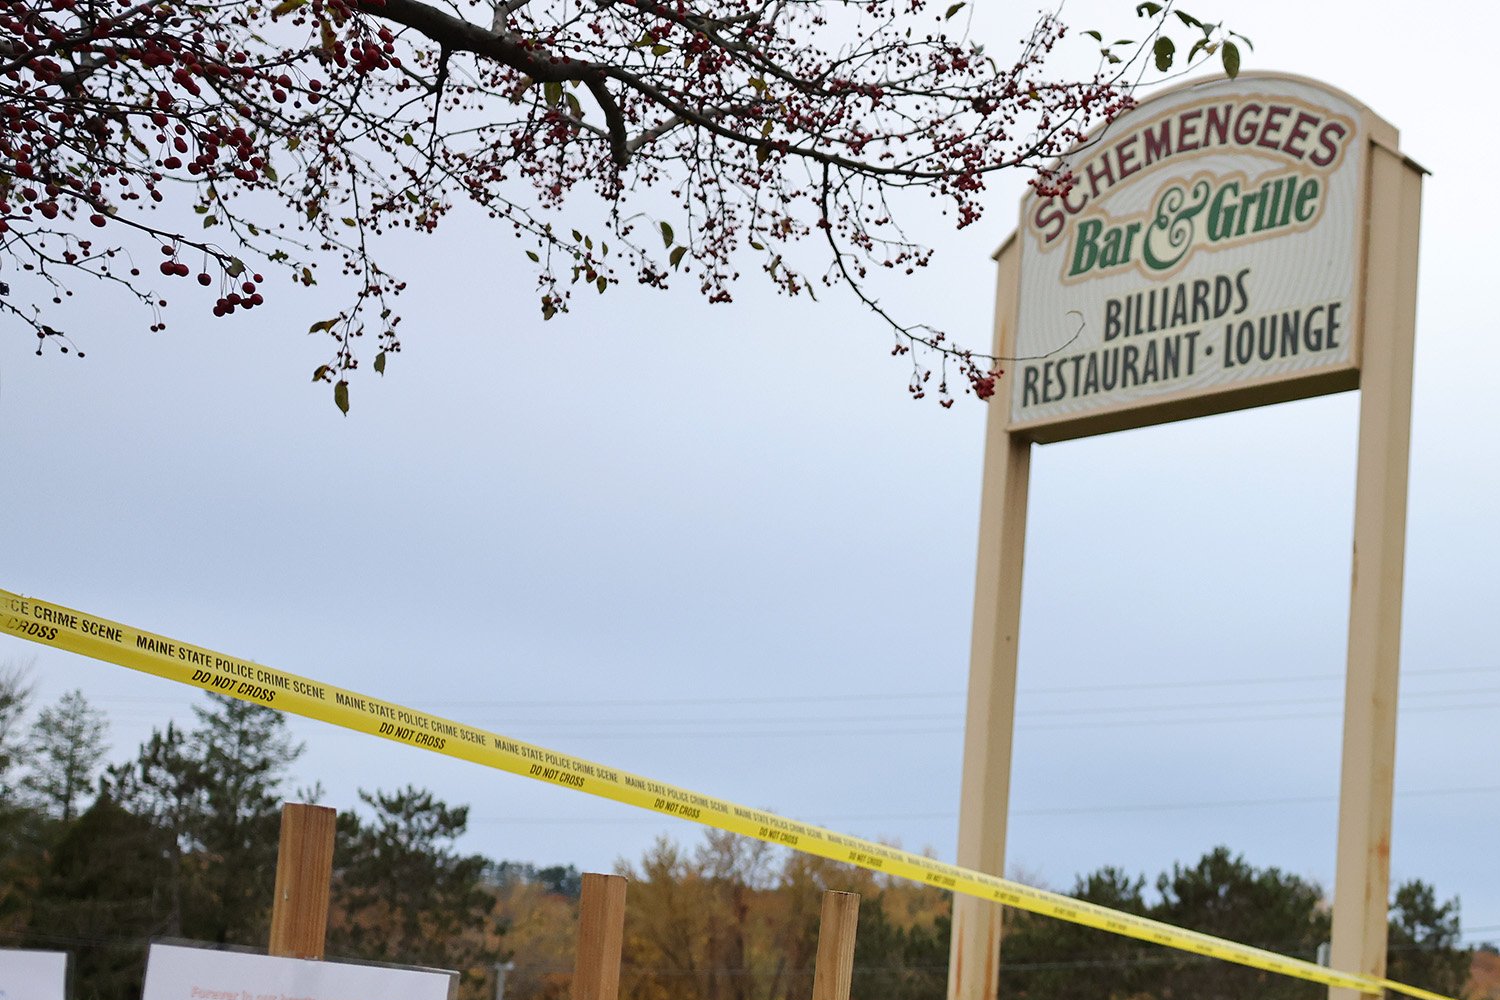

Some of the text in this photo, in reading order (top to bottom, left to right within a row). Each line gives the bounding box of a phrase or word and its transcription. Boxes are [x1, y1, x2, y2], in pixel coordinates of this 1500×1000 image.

[1034, 103, 1347, 243] SCHEMENGEES
[1067, 175, 1320, 277] Bar & Grille
[1104, 269, 1251, 342] BILLIARDS
[1022, 302, 1342, 408] RESTAURANT LOUNGE
[34, 605, 77, 630] CRIME
[81, 619, 122, 643] SCENE
[136, 634, 325, 700] MAINE STATE POLICE CRIME SCENE
[192, 669, 276, 702] DO NOT CROSS
[336, 692, 486, 746] MAINE STATE POLICE CRIME SCENE
[379, 722, 446, 750] DO NOT CROSS
[494, 738, 618, 783] MAINE STATE POLICE CRIME SCENE
[530, 764, 585, 788] DO NOT CROSS
[625, 776, 646, 790] MAINE
[647, 782, 666, 796] STATE
[654, 798, 701, 819] DO NOT CROSS
